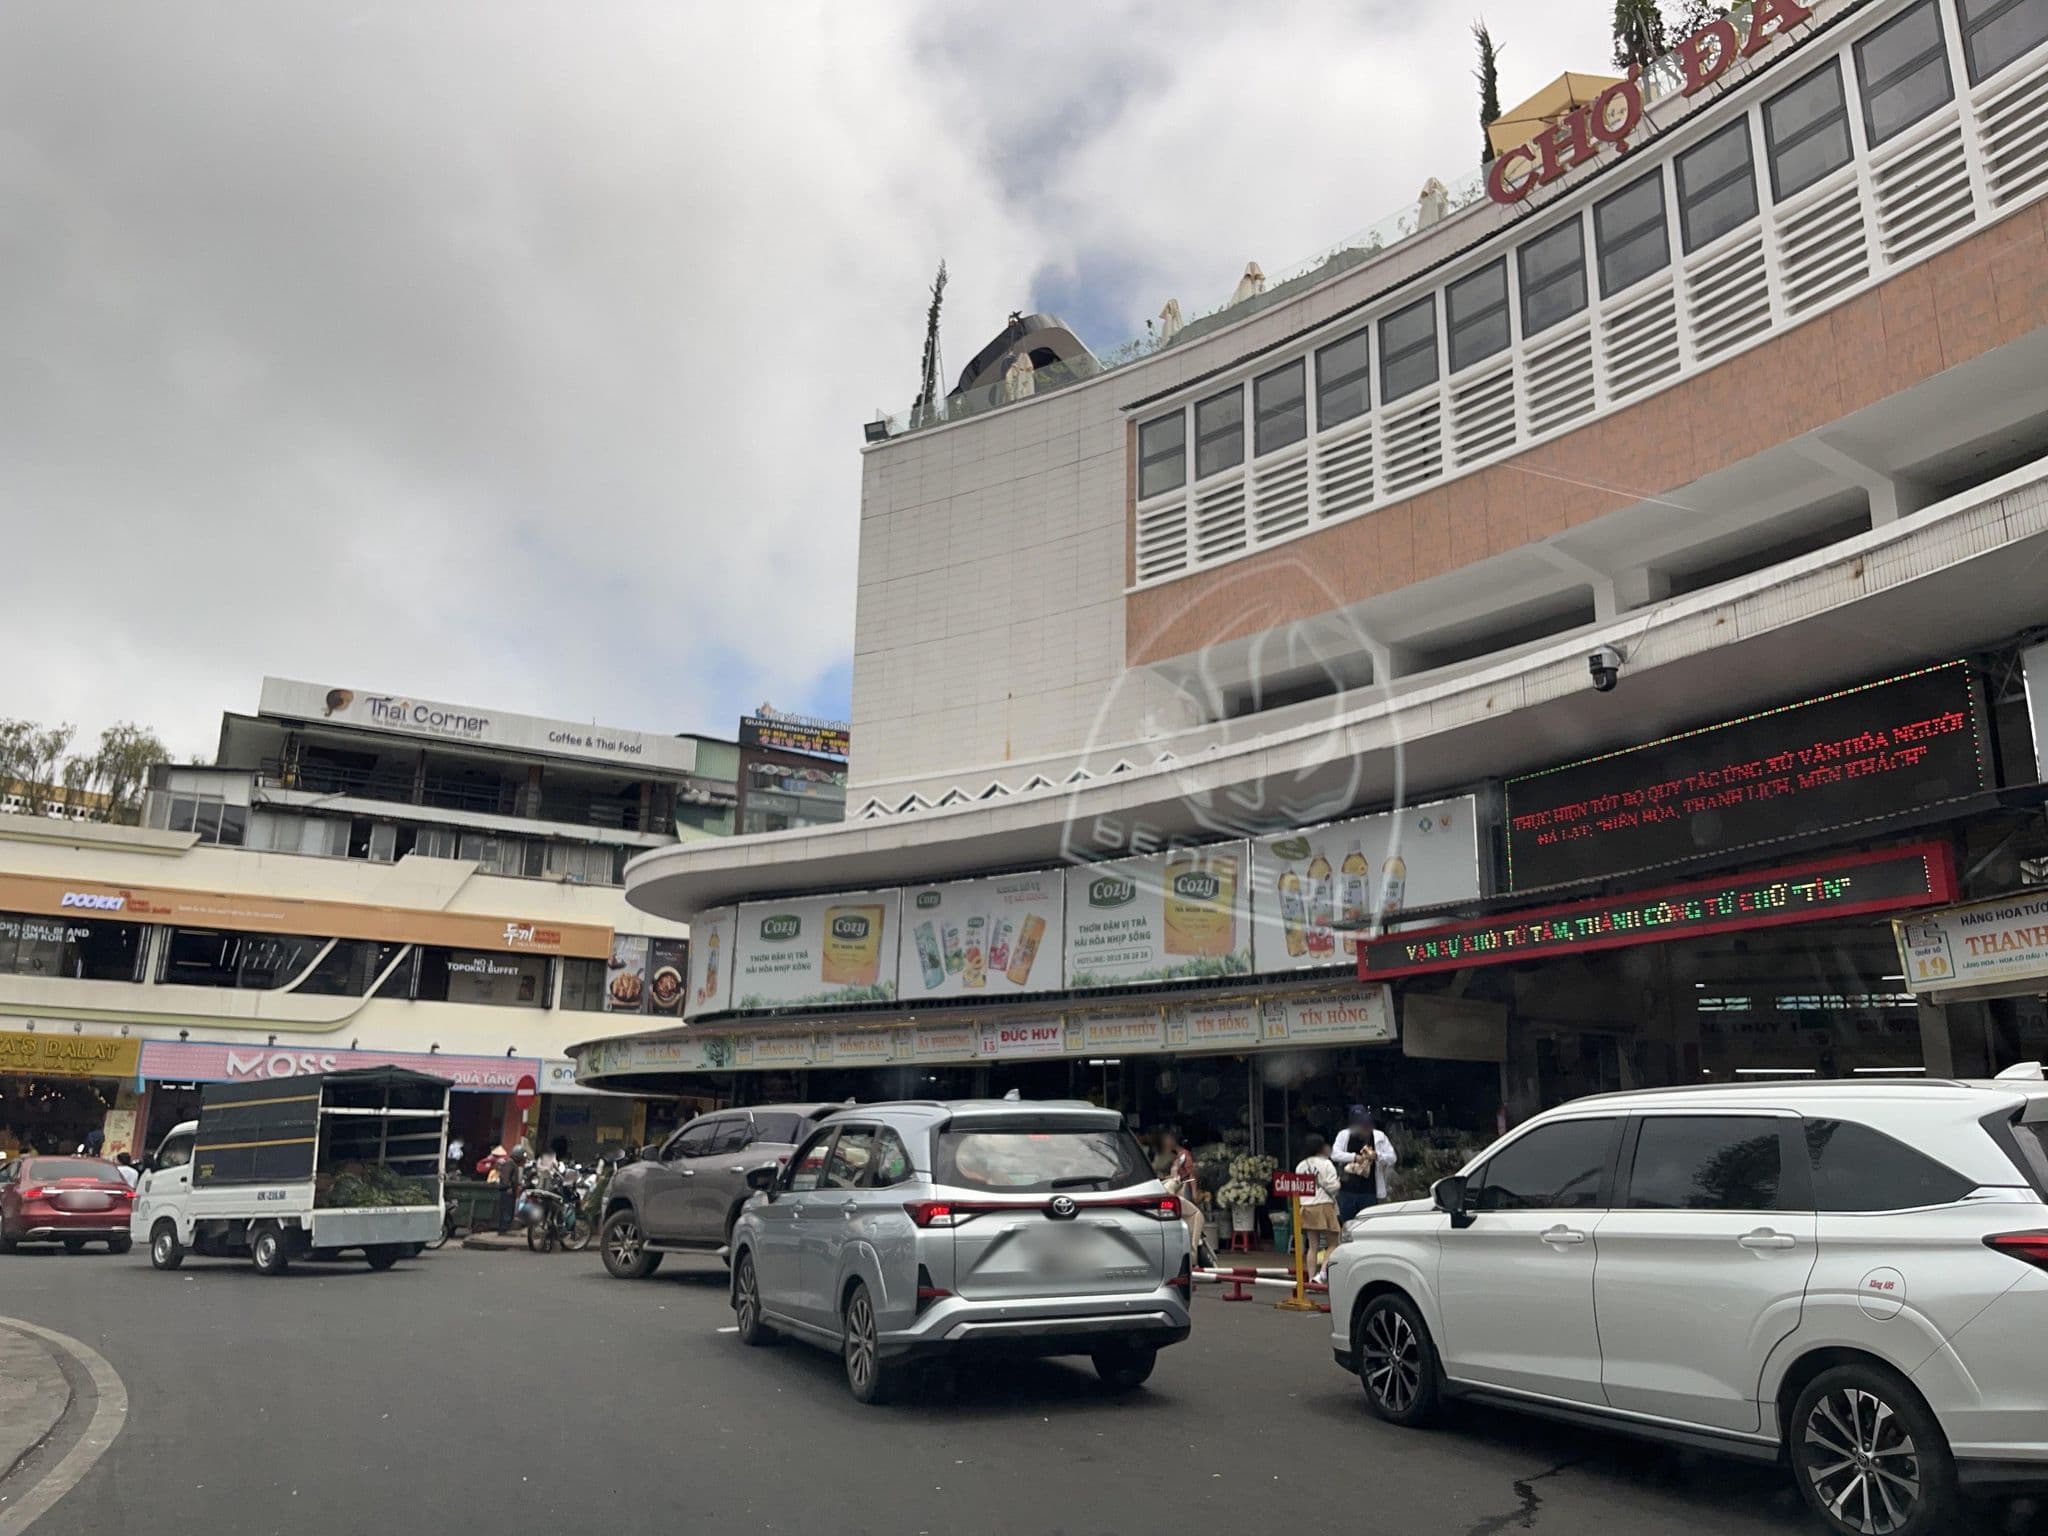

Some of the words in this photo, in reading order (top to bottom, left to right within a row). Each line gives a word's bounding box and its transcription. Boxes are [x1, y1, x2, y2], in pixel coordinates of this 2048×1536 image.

[1487, 62, 1644, 205] CHỢ
[365, 696, 409, 720] Thai
[413, 704, 490, 732] Corner
[549, 731, 582, 747] Coffee
[586, 737, 594, 748] &
[596, 738, 616, 751] Thai
[618, 740, 642, 754] Food
[1093, 880, 1131, 900] Cozy
[1177, 875, 1215, 897] Cozy
[61, 891, 125, 911] DOOKKI
[764, 919, 798, 935] Cozy
[835, 918, 866, 935] Cozy
[1960, 911, 1994, 926] HÀNG
[1996, 906, 2021, 920] HOA
[1406, 942, 1437, 962] VẠN
[1440, 934, 1461, 958] SỰ
[1643, 900, 1701, 925] CÔNG
[1965, 925, 2048, 957] THANH
[447, 962, 486, 973] TOPOKKI
[488, 965, 519, 976] BUFFET
[1918, 956, 1949, 979] 19
[1299, 1008, 1323, 1025] TÍN
[1327, 1002, 1369, 1024] HỒNG
[1032, 1028, 1059, 1041] HUY
[226, 1050, 337, 1078] MOSS
[1275, 1174, 1290, 1193] CẤM
[1306, 1181, 1315, 1193] XE
